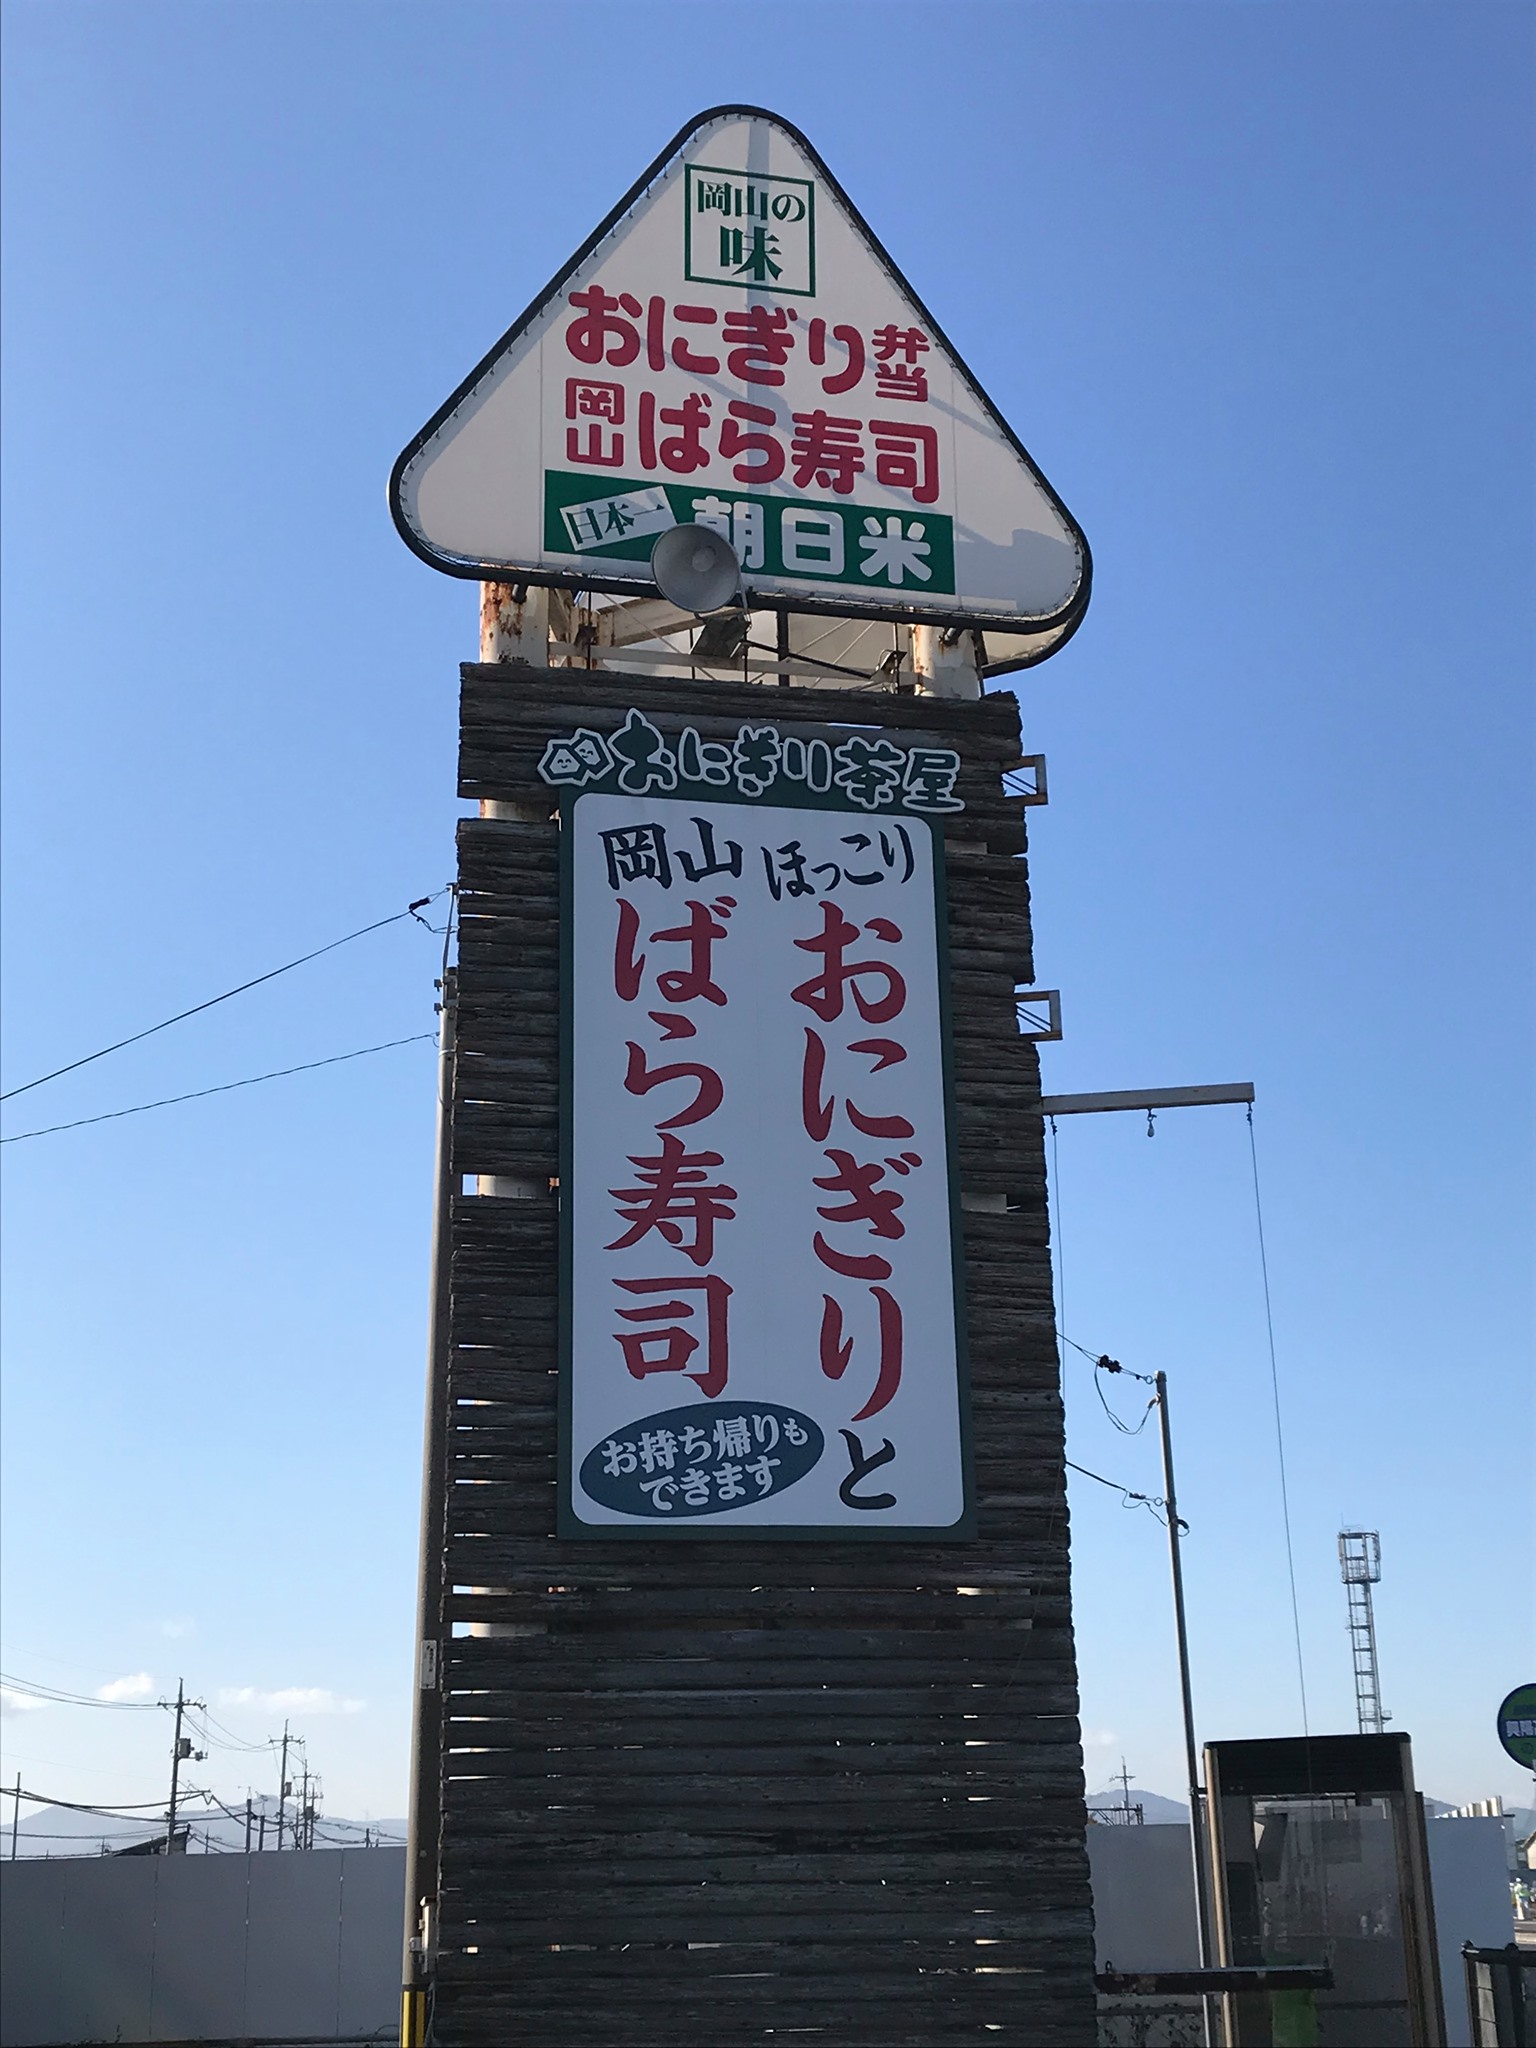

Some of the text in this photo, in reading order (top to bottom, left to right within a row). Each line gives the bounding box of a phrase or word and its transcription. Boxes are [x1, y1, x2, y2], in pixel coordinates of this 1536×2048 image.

[697, 178, 806, 223] 岡山の
[719, 225, 784, 282] 味
[566, 501, 665, 544] 日本一
[608, 707, 966, 813] おにぎり茶屋
[597, 817, 743, 890] 岡山
[760, 823, 915, 901] ほっこり
[603, 896, 738, 1399] ばら寿司
[602, 1414, 808, 1477] お持ち帰りも
[640, 1455, 782, 1511] できます
